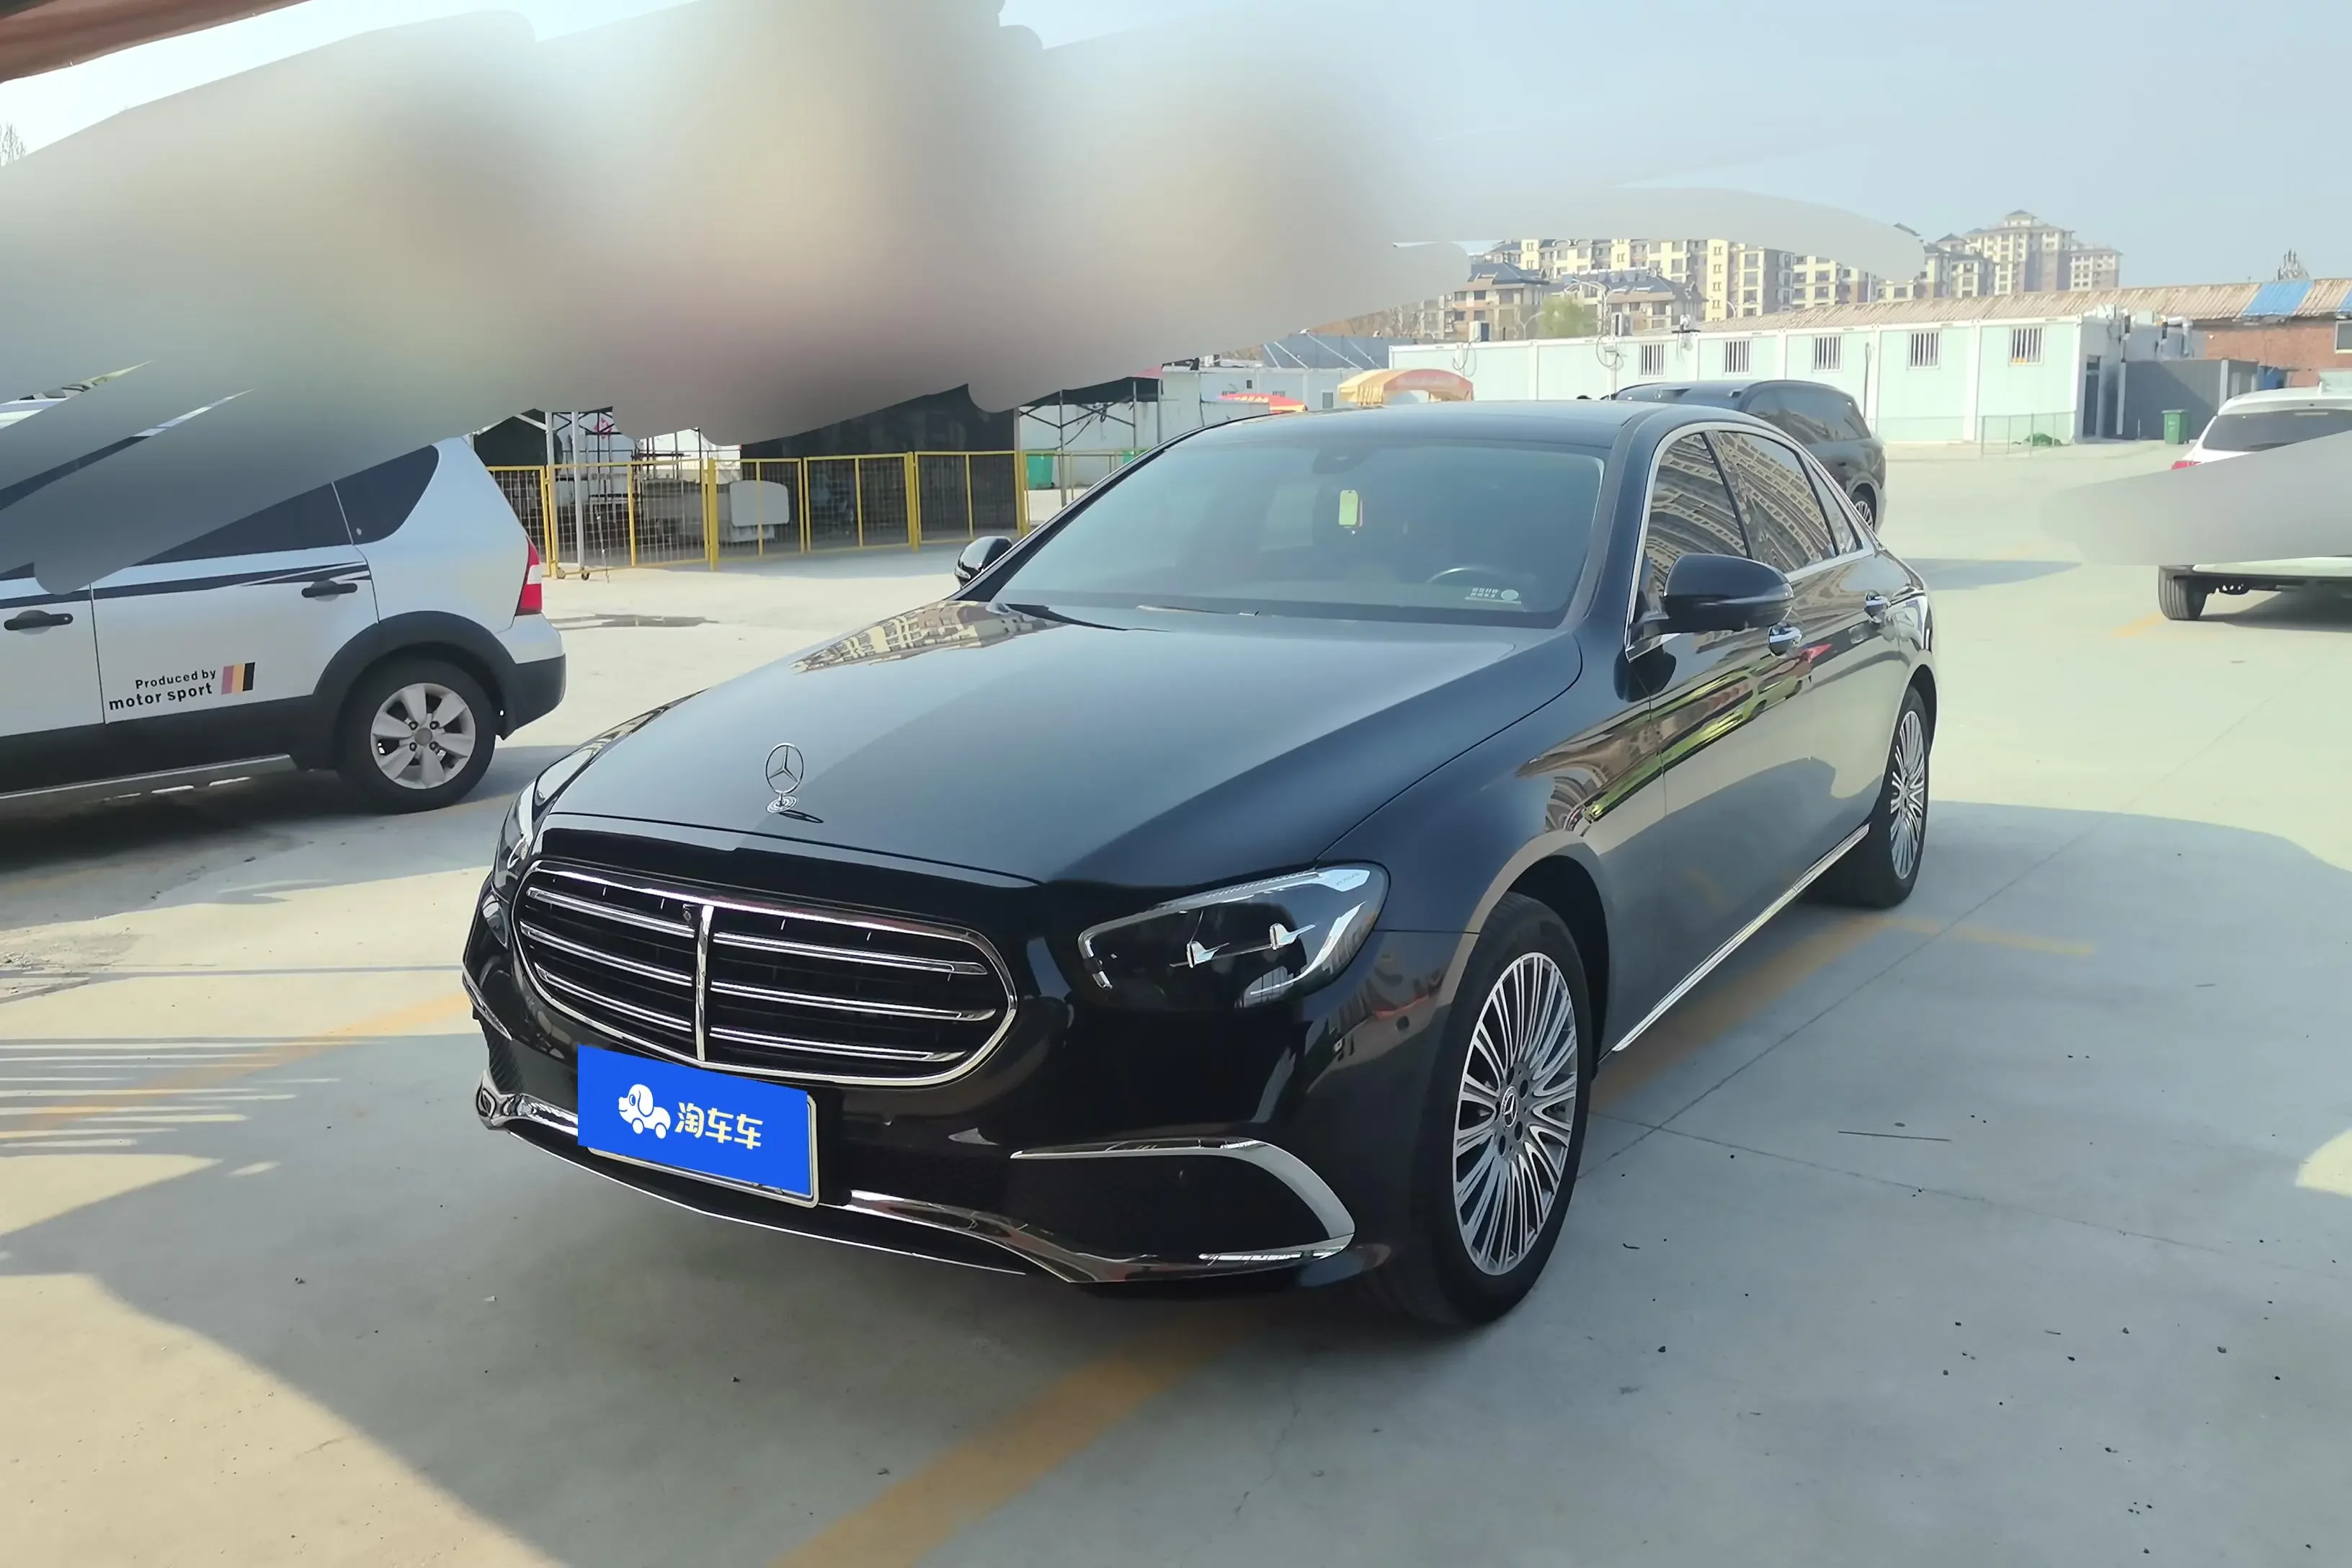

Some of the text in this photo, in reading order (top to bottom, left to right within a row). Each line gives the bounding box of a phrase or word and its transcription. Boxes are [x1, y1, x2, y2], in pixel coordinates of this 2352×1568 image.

[135, 669, 215, 689] Produced by
[109, 682, 213, 710] motor sport
